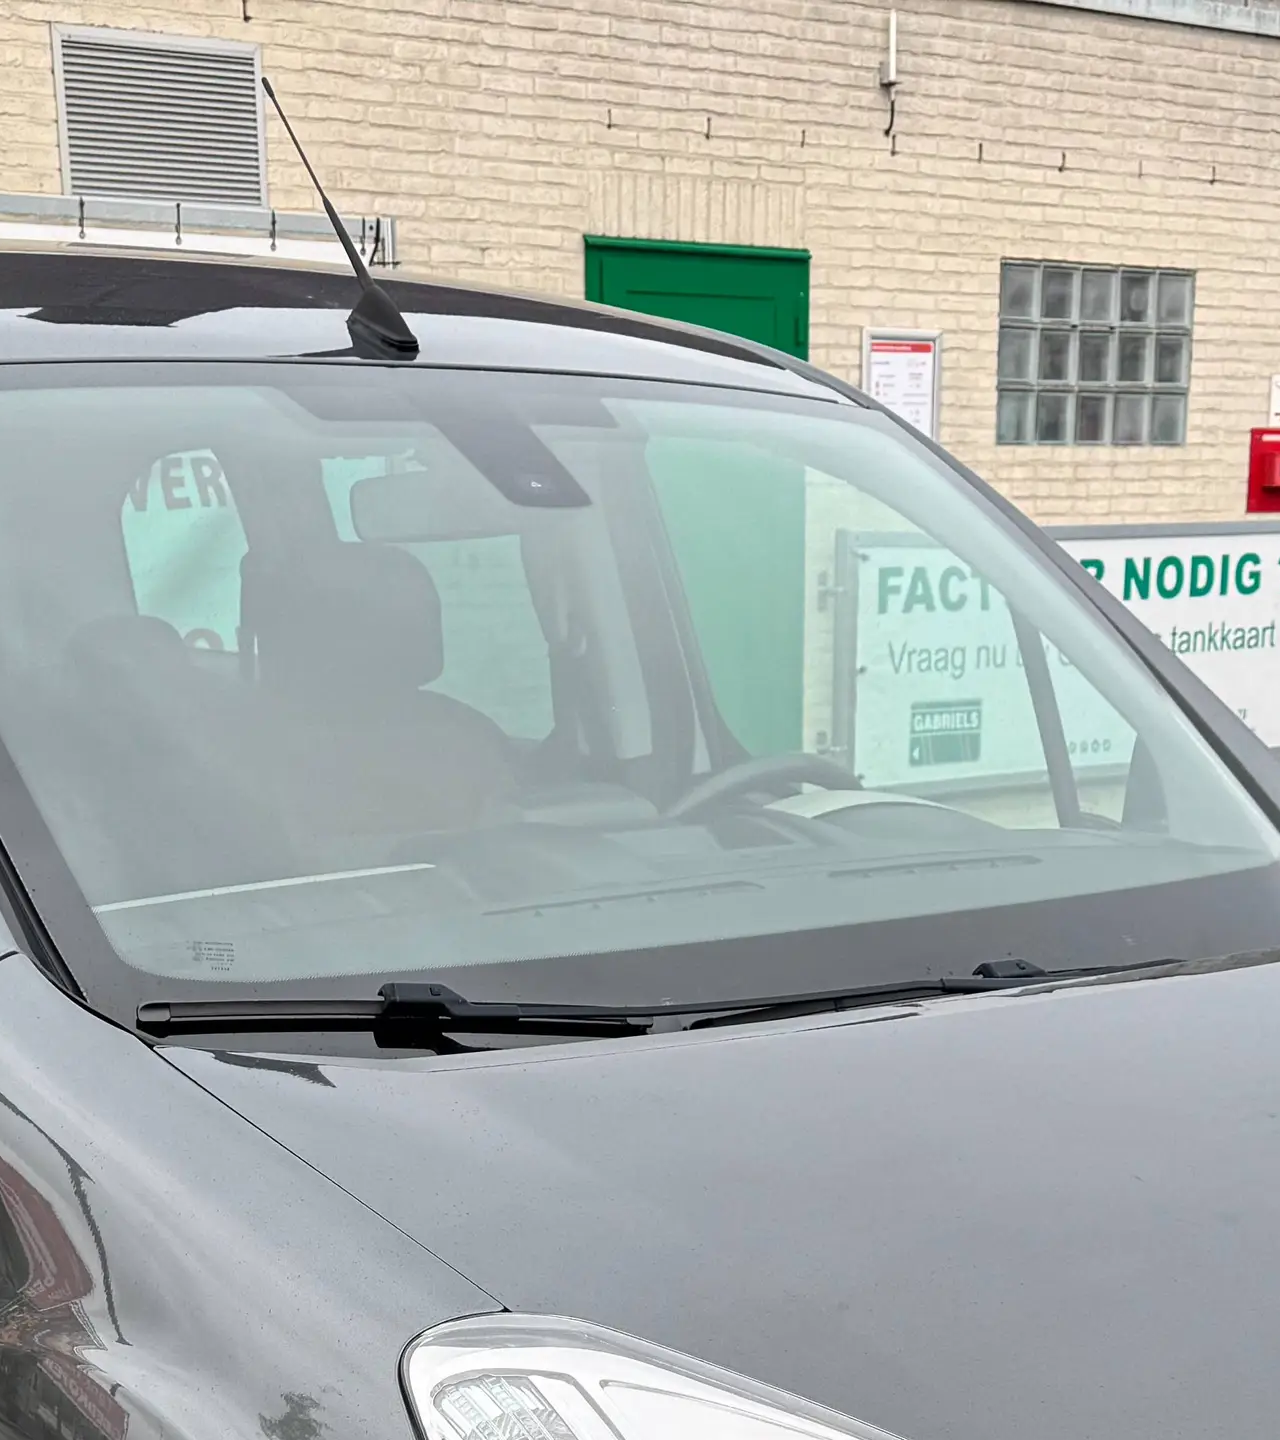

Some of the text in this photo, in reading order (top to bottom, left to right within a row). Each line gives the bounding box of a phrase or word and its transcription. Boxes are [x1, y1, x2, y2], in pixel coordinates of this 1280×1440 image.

[1123, 552, 1262, 601] NODIG
[888, 640, 967, 680] Vraag
[976, 644, 1007, 669] nu
[1170, 619, 1276, 655] tankkaart
[913, 711, 979, 731] GABRIELS
